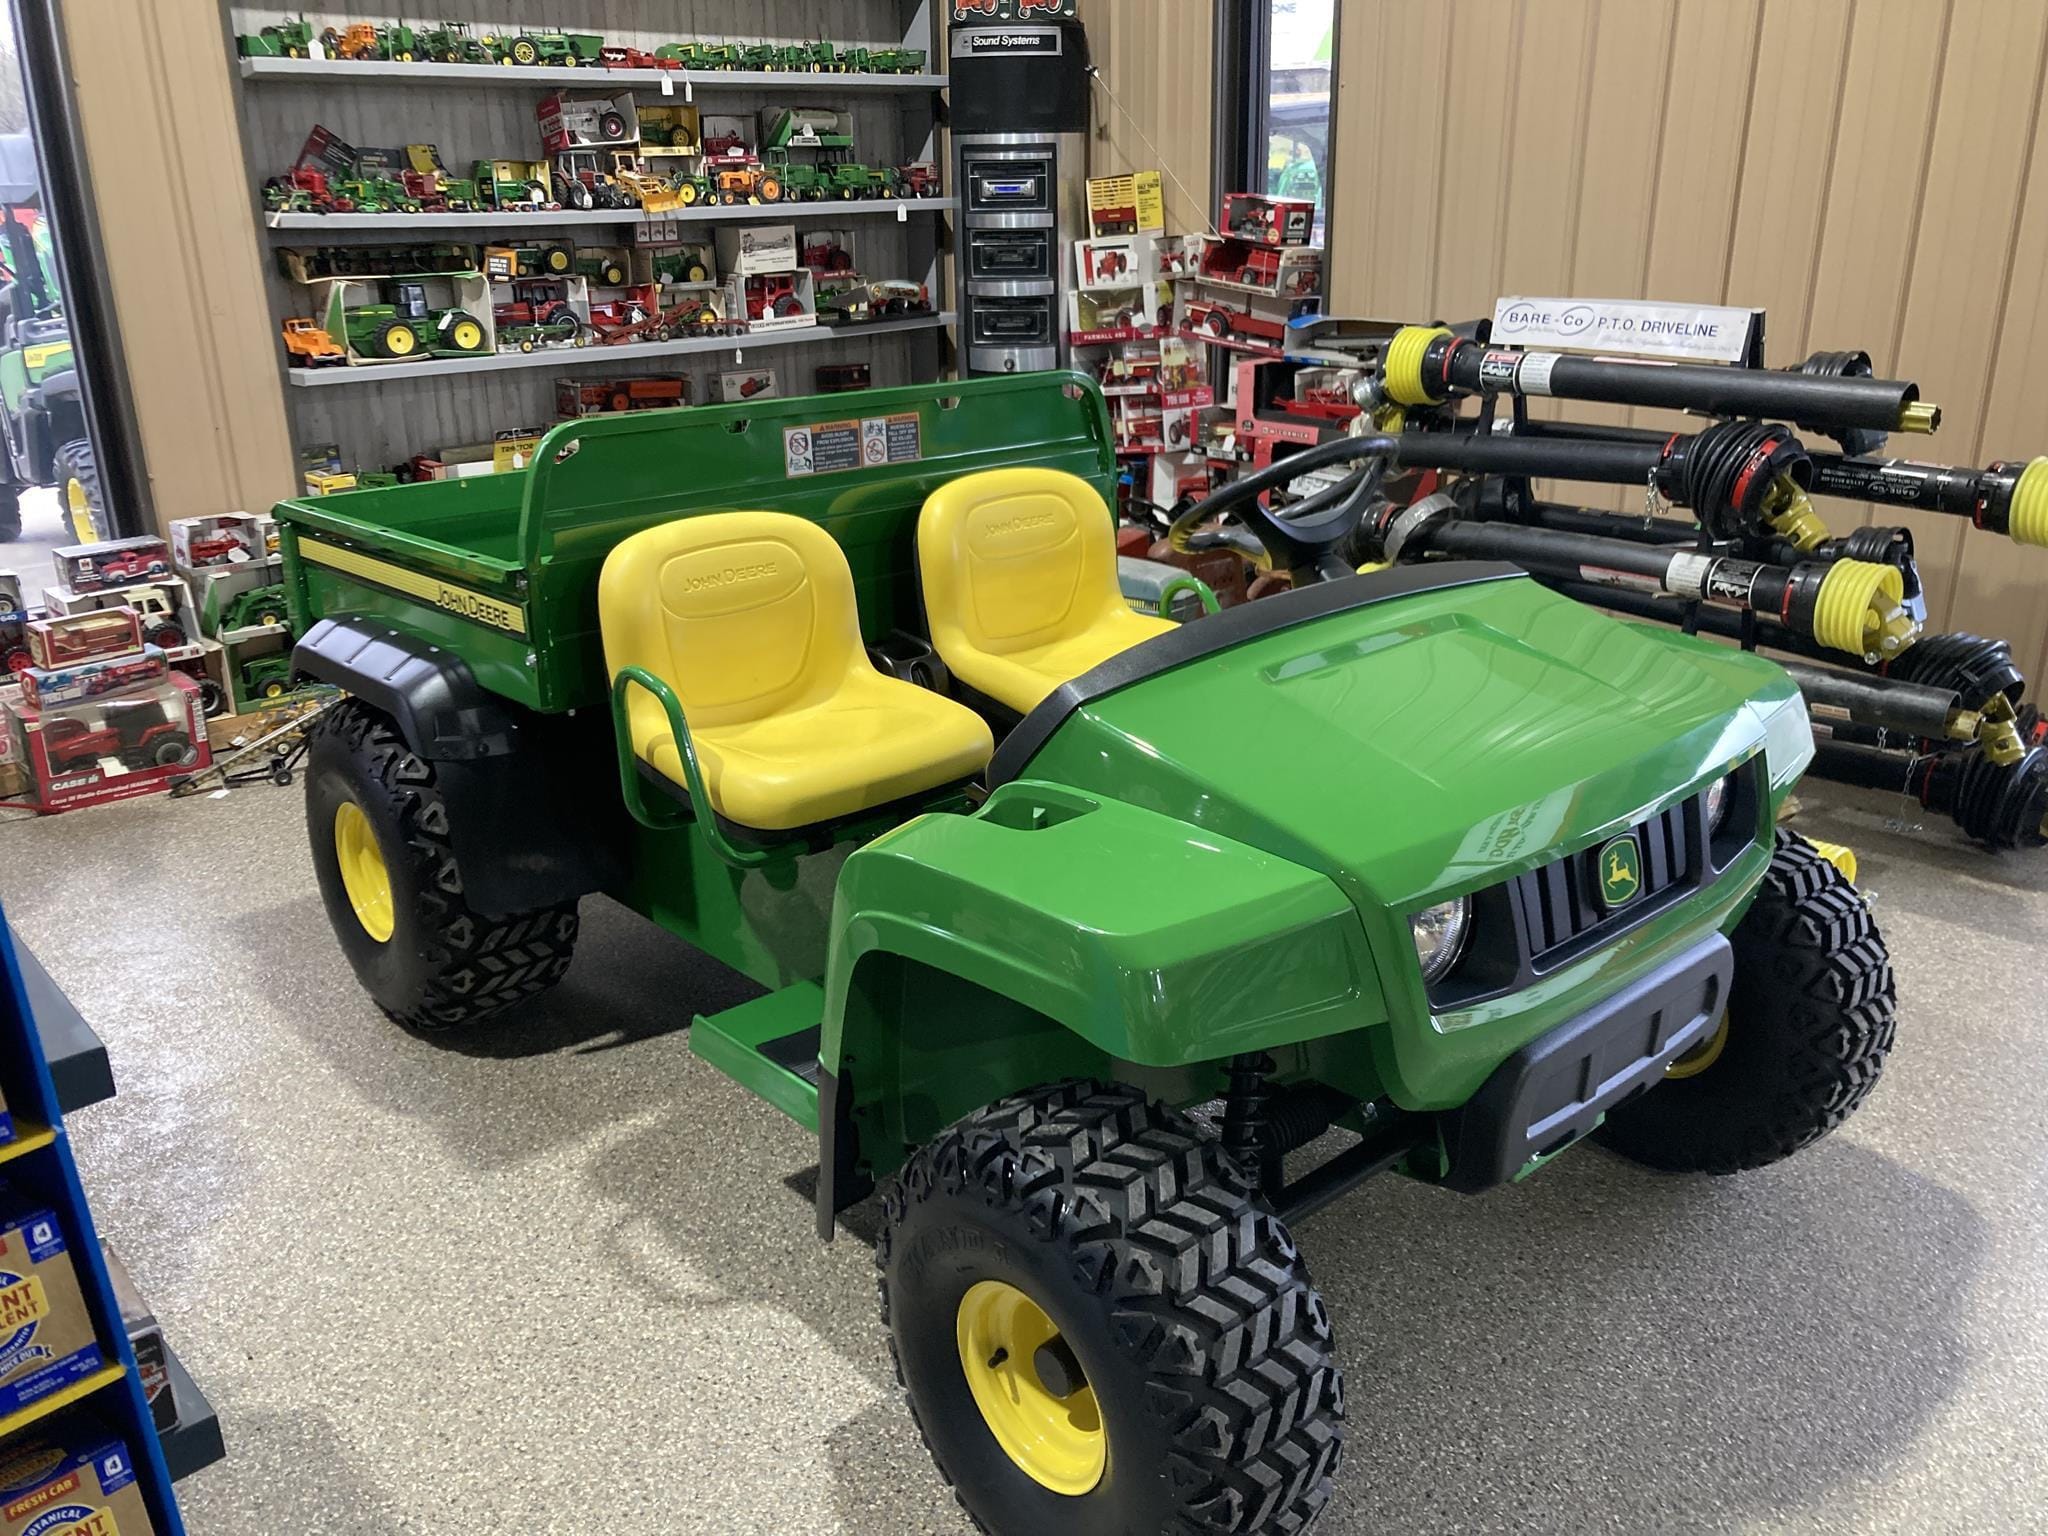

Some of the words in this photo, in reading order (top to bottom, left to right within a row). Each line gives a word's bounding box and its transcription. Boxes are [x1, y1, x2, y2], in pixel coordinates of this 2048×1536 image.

[972, 36, 1000, 46] Sound
[1001, 35, 1040, 46] Systems
[1509, 312, 1551, 325] BARE
[1563, 315, 1584, 327] Co
[1597, 317, 1637, 331] P.T.O.
[1640, 320, 1719, 337] DRIVELINE
[985, 520, 1012, 538] JOHN
[1013, 511, 1056, 532] DEERE
[684, 573, 722, 593] JOHN
[723, 562, 777, 584] DEERE
[435, 584, 469, 615] JOHN
[469, 595, 511, 629] DEERE
[52, 779, 86, 790] CASE
[38, 1227, 48, 1239] 4
[19, 1348, 38, 1363] OUT
[108, 1460, 119, 1471] 4
[9, 1492, 47, 1517] FRESH
[49, 1479, 74, 1497] CAB
[22, 1509, 81, 1536] OTANICAL
